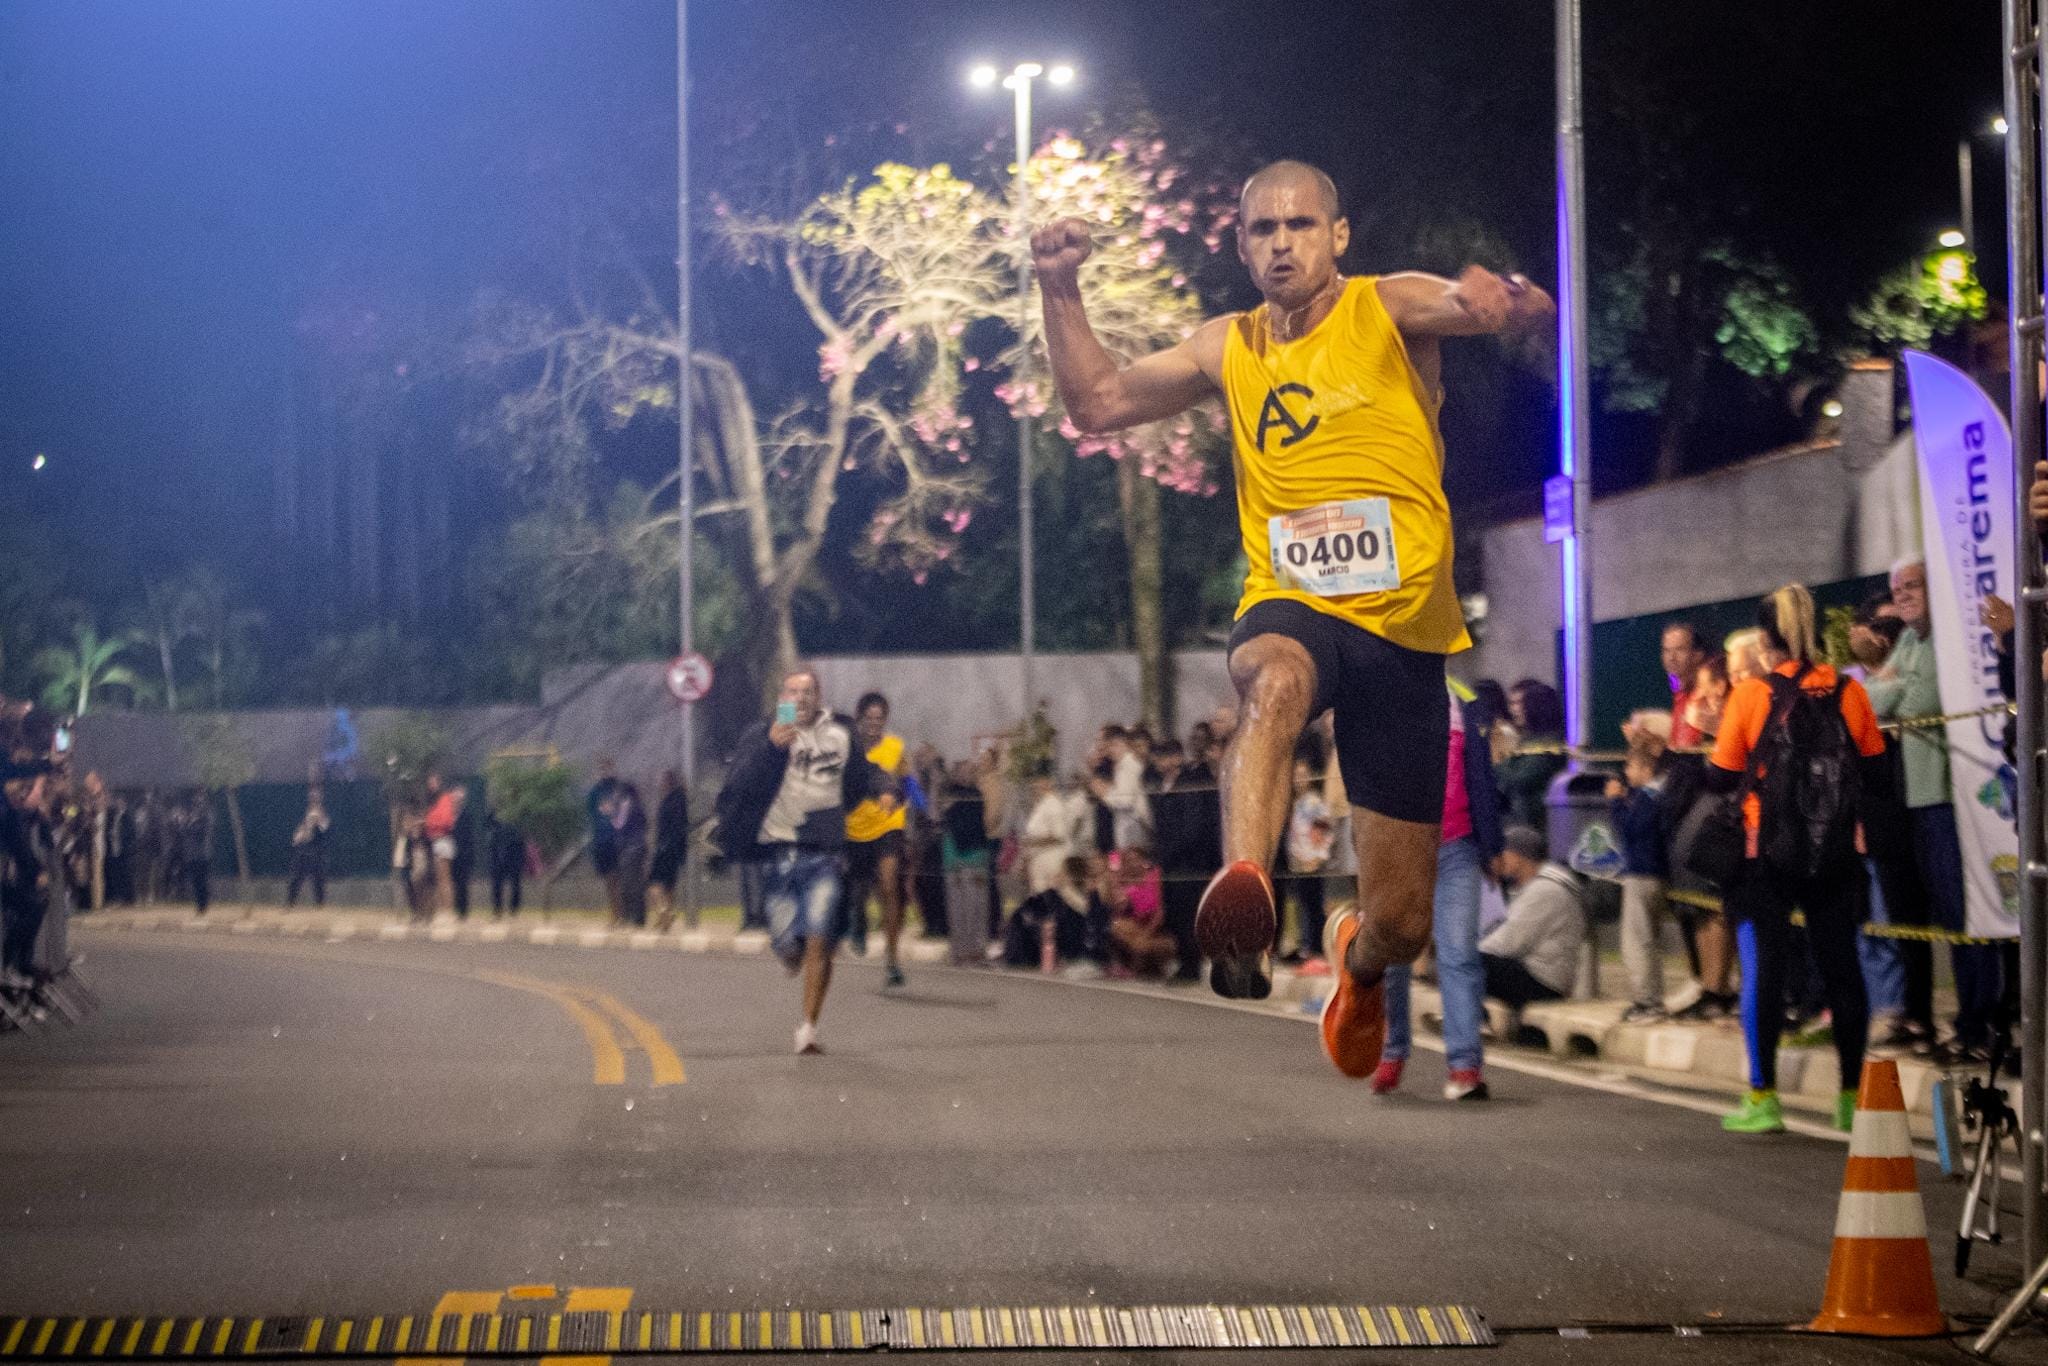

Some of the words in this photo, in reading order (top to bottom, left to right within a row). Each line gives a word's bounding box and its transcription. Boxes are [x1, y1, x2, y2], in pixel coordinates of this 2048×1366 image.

[1956, 497, 1968, 525] DE
[1286, 530, 1379, 566] 0400
[1318, 565, 1350, 577] MARCIO
[1964, 421, 2006, 749] Guaarema
